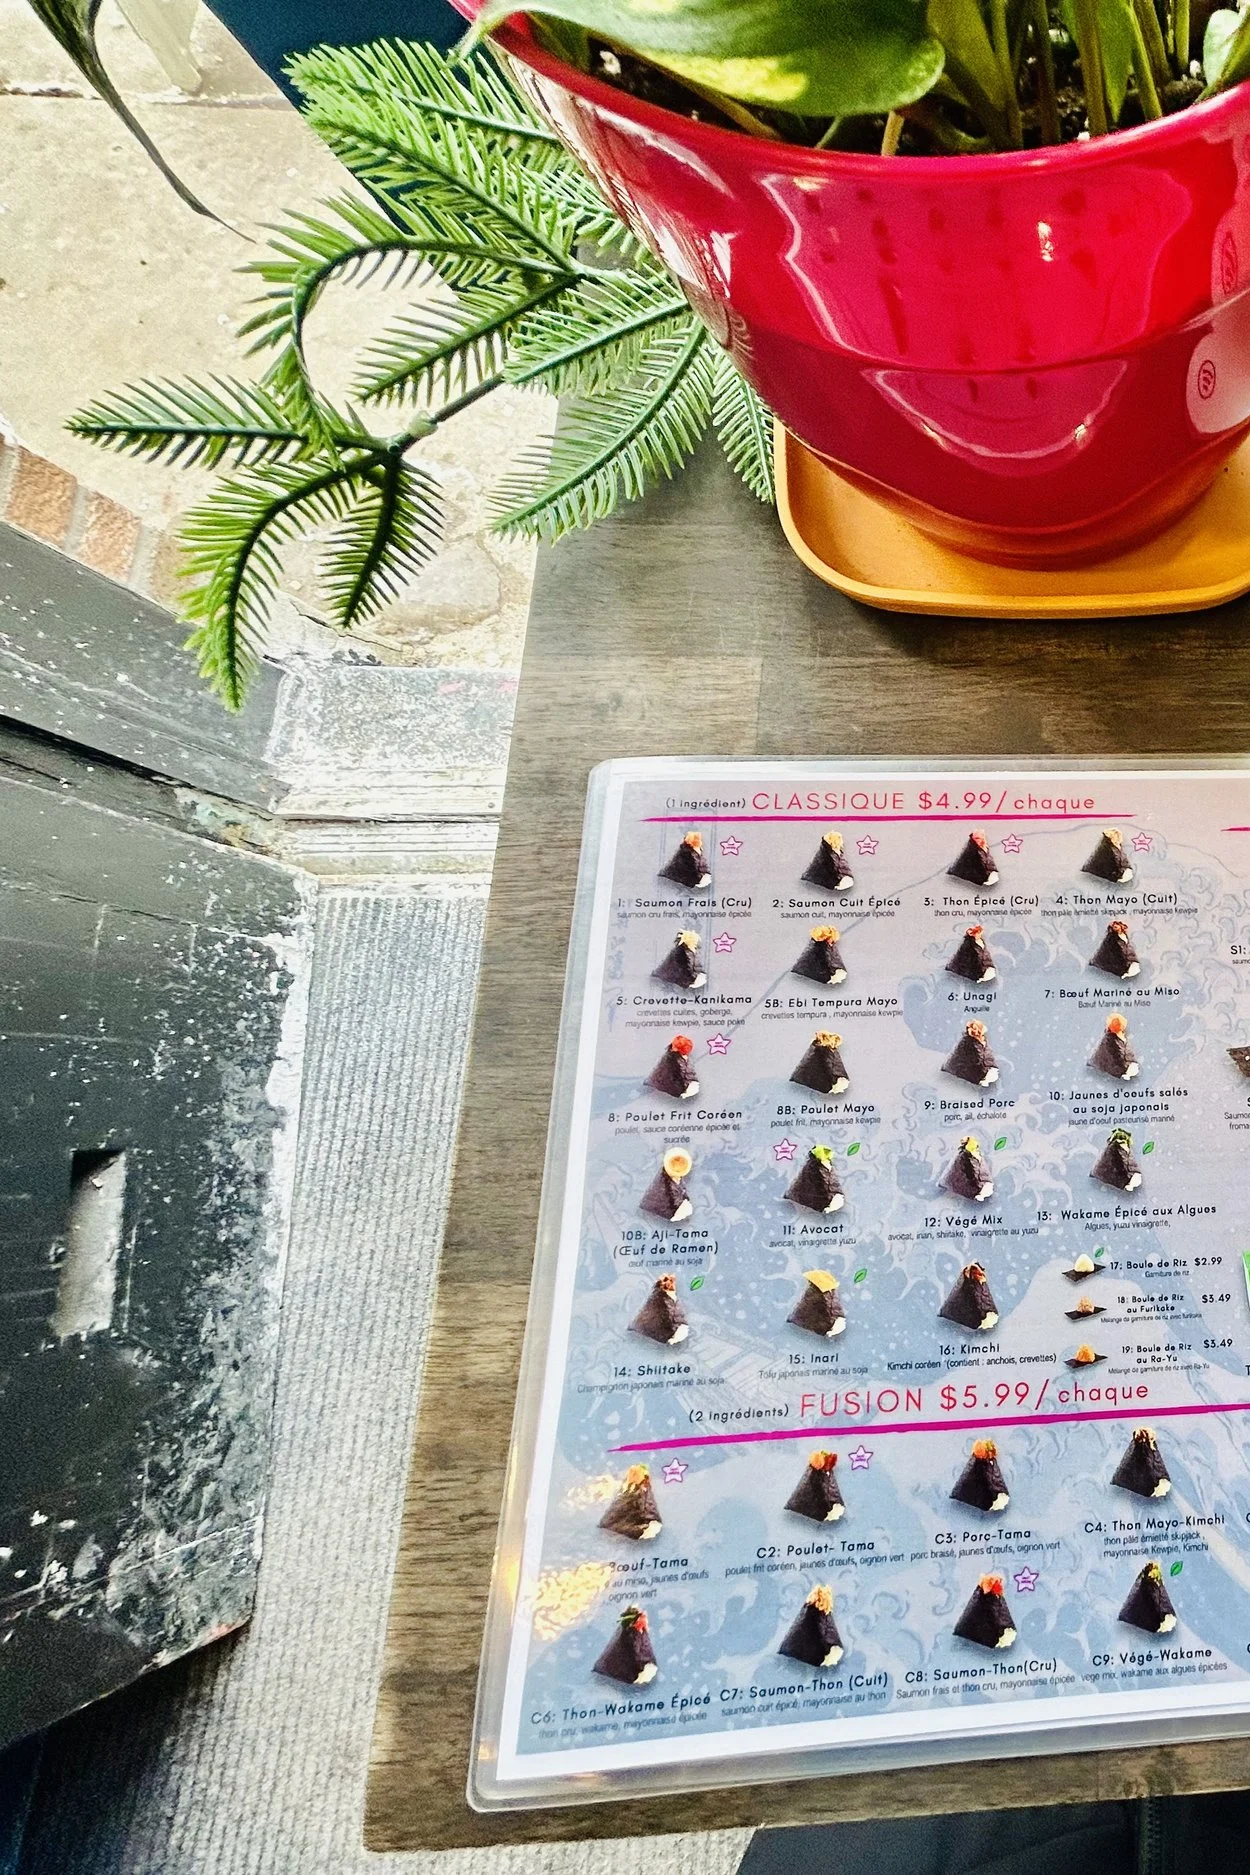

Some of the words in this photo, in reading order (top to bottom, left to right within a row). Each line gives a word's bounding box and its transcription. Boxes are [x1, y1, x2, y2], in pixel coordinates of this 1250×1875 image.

[680, 798, 746, 810] ingrédient)
[752, 792, 904, 810] CLASSIQUE
[634, 898, 683, 908] Saumon
[688, 898, 717, 908] Frais
[721, 897, 752, 908] (Cru)
[772, 899, 784, 908] 2:
[788, 899, 834, 908] Saumon
[839, 898, 864, 908] Cuit
[868, 896, 900, 910] Épicé
[924, 897, 934, 906] 3:
[943, 897, 970, 906] Thon
[974, 894, 1005, 908] Épicé
[1010, 896, 1039, 907] (Cru)
[1056, 895, 1068, 905] 4:
[1073, 895, 1101, 904] Thon
[1106, 894, 1138, 906] Mayo
[1142, 894, 1178, 905] (Cuit)
[1230, 945, 1247, 955] S1:
[764, 998, 784, 1008] 5B:
[788, 998, 809, 1008] Ebi
[812, 997, 864, 1010] Tempura
[868, 997, 898, 1008] Mayo
[948, 992, 959, 1002] 6:
[964, 992, 997, 1003] Unagi
[608, 1112, 620, 1122] 8:
[625, 1112, 666, 1122] Poulet
[670, 1110, 692, 1120] Frit
[696, 1109, 742, 1120] Coréen
[1036, 1211, 1052, 1222] 13:
[1060, 1209, 1110, 1220] Wakame
[1114, 1206, 1148, 1217] Épicé
[1152, 1207, 1173, 1216] aux
[1177, 1205, 1216, 1216] Algues
[940, 1344, 955, 1355] 16:
[960, 1343, 1000, 1354] Kimchi
[688, 1410, 704, 1423] (2
[708, 1404, 790, 1423] ingrédients)
[800, 1388, 922, 1417] FUSION
[720, 1689, 743, 1701] C7:
[750, 1680, 844, 1700] Saumon-Thon
[848, 1672, 888, 1692] (Cuit)
